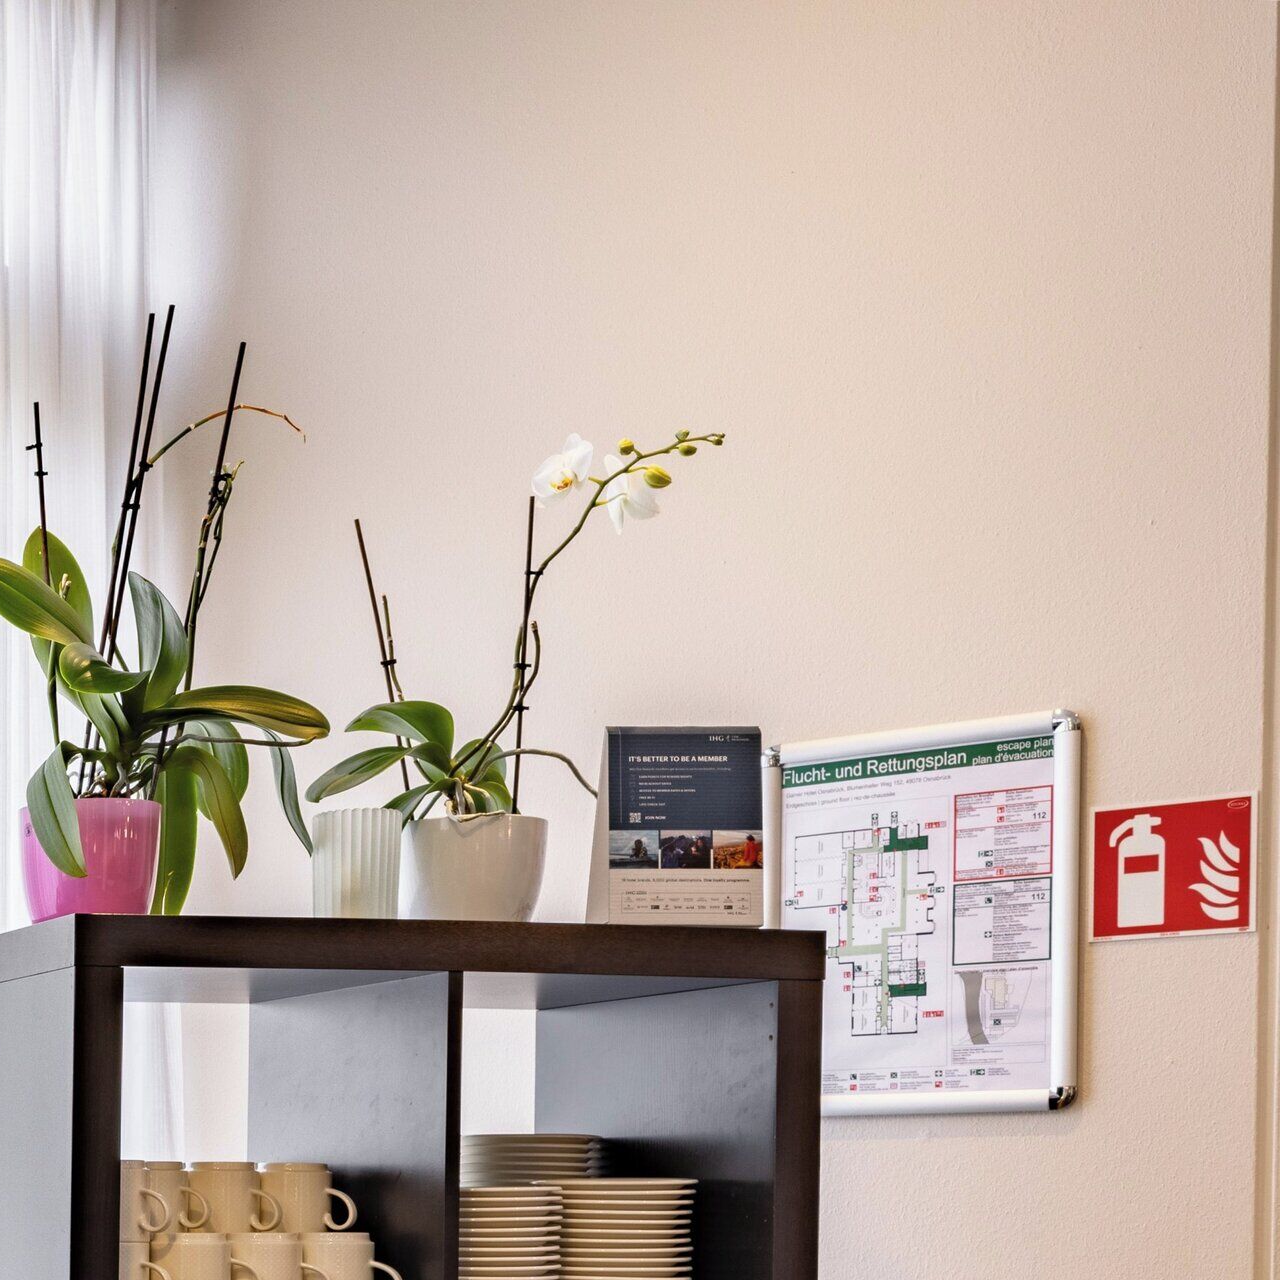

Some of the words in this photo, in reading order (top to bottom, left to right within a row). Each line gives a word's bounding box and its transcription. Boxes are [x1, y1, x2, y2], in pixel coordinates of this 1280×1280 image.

[996, 740, 1032, 753] escape
[1033, 737, 1054, 750] plan
[971, 755, 993, 766] plan
[994, 748, 1054, 764] d'évacuation
[783, 770, 831, 786] Flucht-
[836, 762, 862, 779] und
[867, 751, 967, 774] Rettungsplan
[1033, 811, 1046, 819] 112
[1032, 892, 1045, 900] 112
